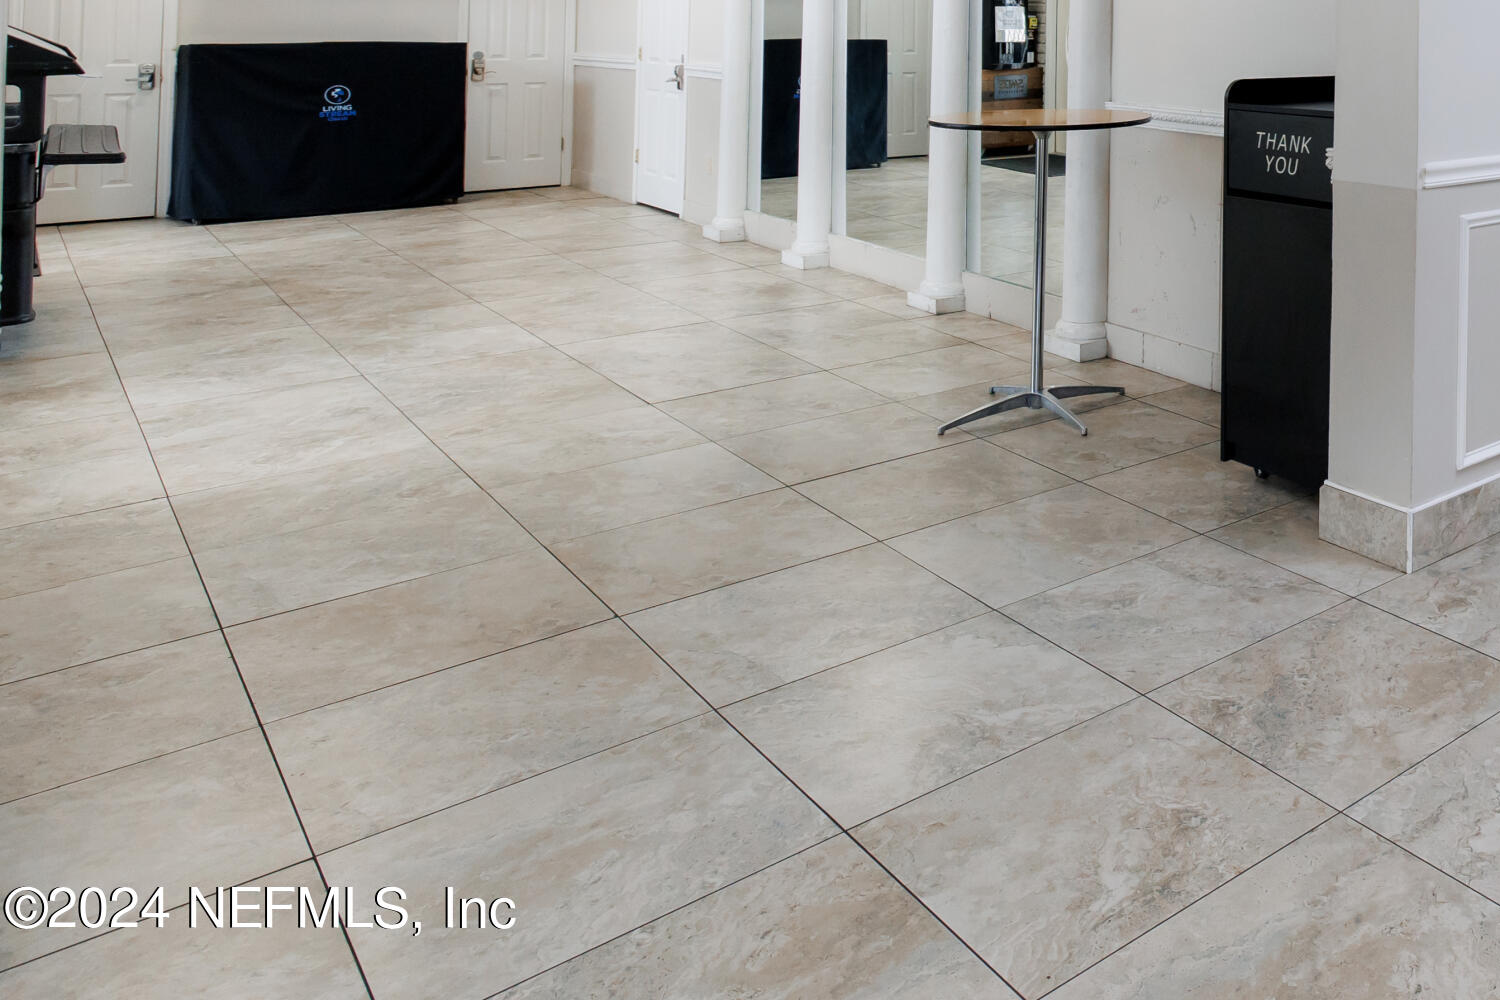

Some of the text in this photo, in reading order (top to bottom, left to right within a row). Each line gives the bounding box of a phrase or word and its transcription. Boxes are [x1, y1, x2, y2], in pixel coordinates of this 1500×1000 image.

[322, 104, 353, 112] LIVING
[1256, 131, 1312, 154] THANK
[1265, 154, 1300, 175] YOU
